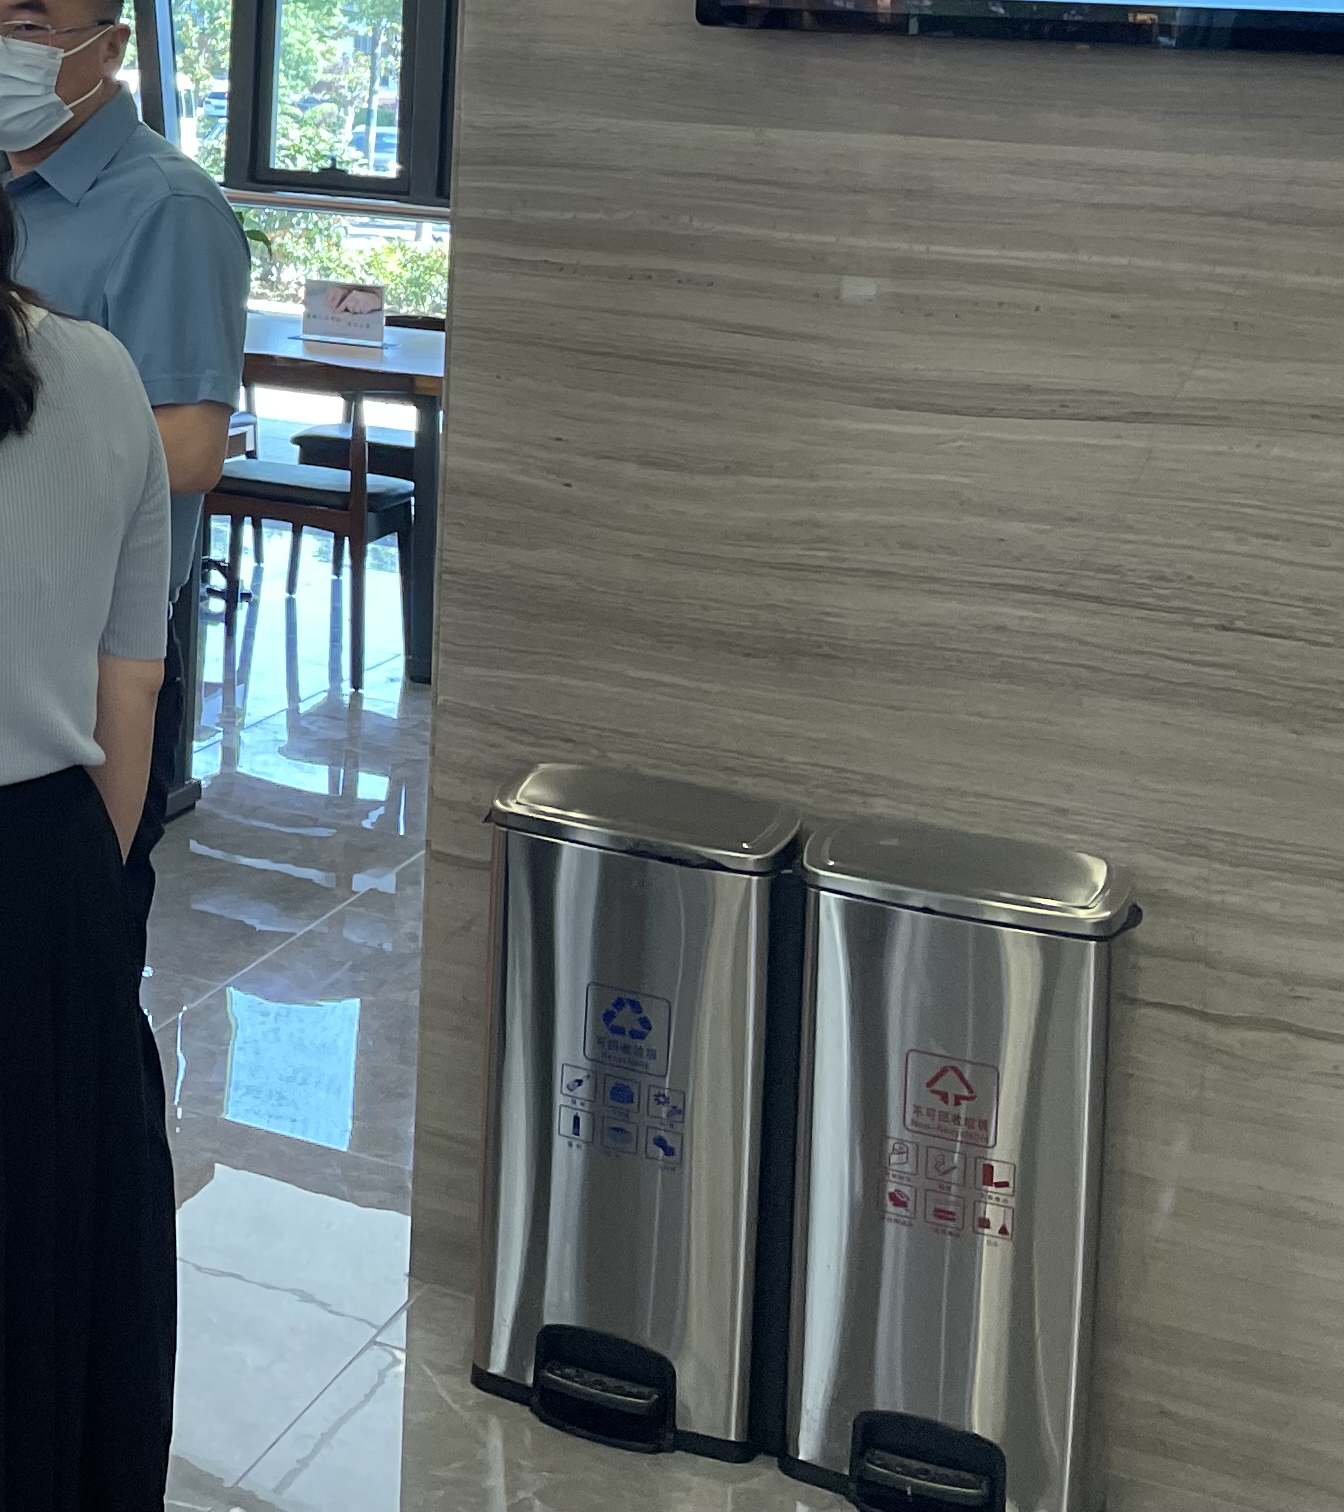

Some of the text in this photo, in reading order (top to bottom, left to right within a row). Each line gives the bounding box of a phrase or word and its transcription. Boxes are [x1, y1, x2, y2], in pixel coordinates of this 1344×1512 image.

[912, 1104, 989, 1133] 不可回收垃圾
